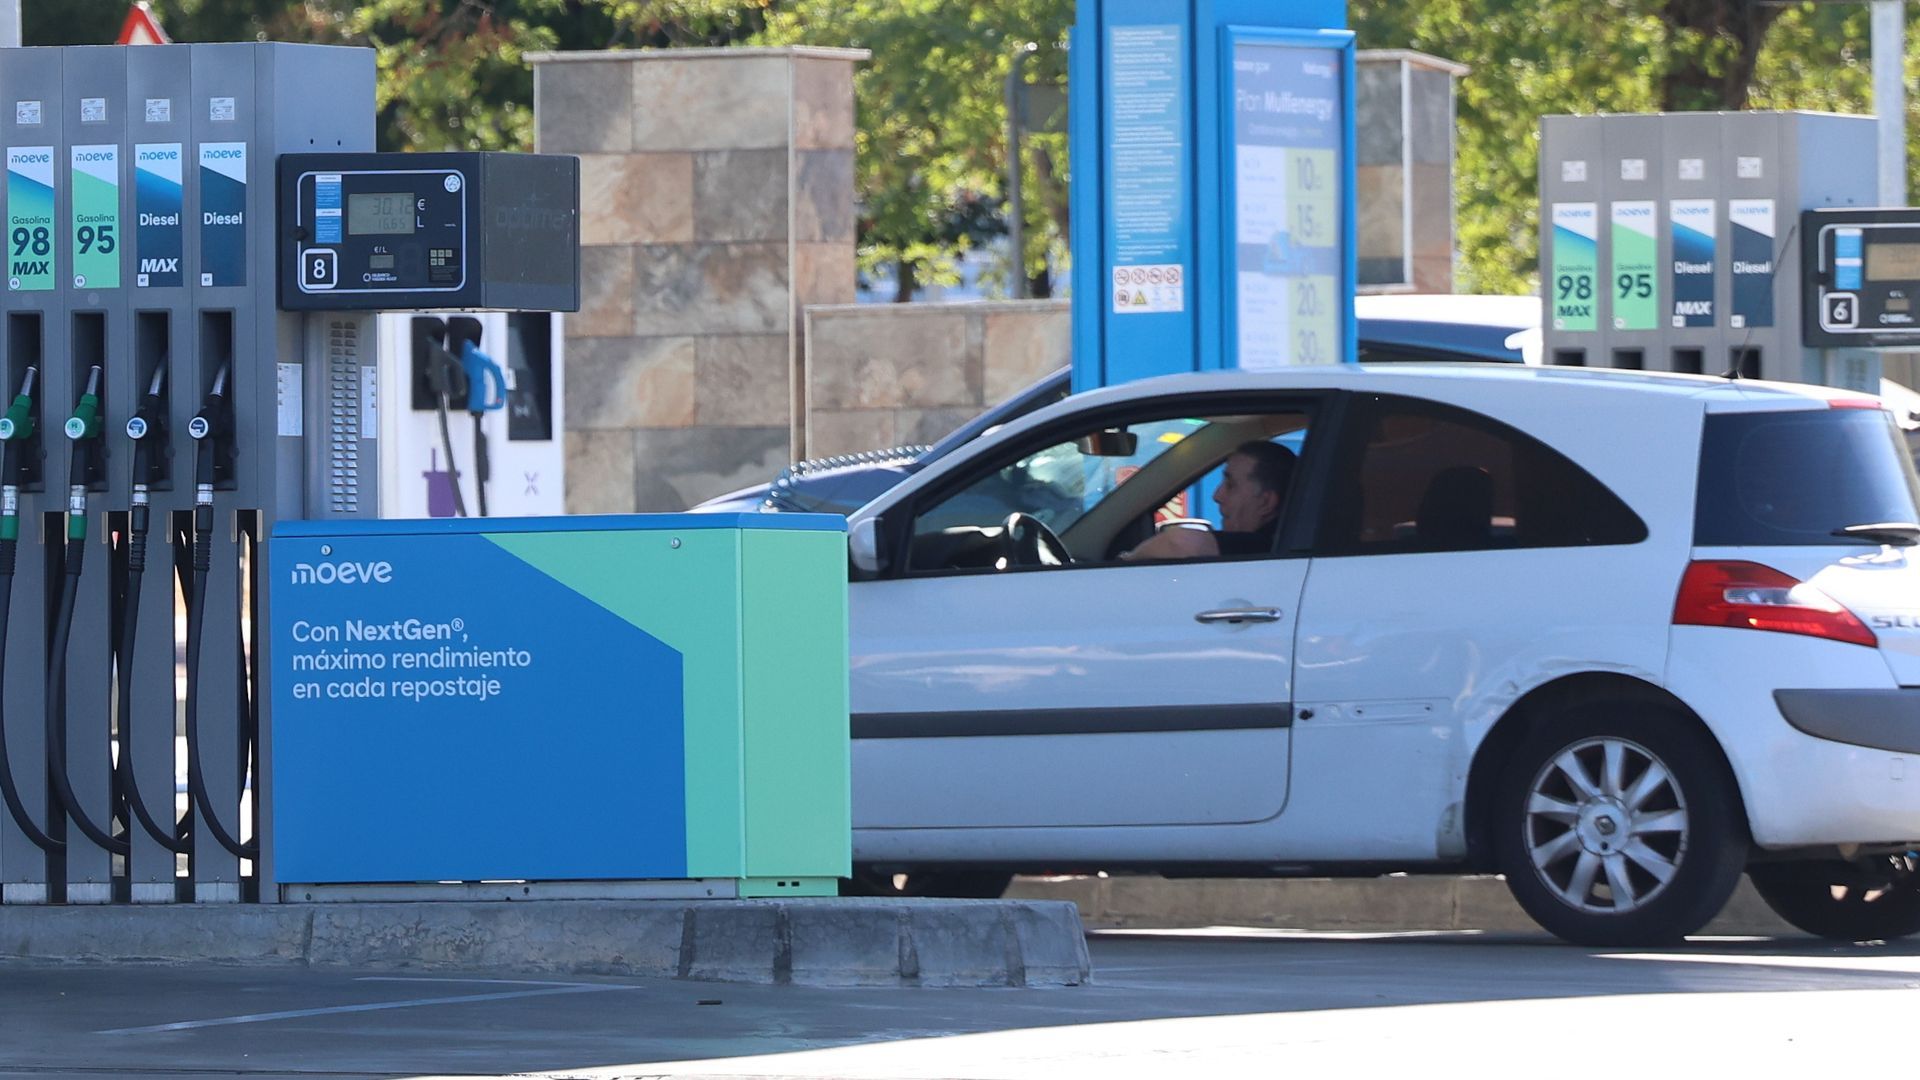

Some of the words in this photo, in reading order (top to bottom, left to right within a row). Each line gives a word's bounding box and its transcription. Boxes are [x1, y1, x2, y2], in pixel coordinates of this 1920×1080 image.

[11, 153, 50, 164] moeve
[75, 152, 113, 162] moeve
[139, 150, 178, 161] moeve
[203, 149, 242, 159] moeve
[12, 215, 50, 225] Gasolina
[76, 213, 115, 223] Gasolina
[139, 213, 179, 226] Diesel
[203, 212, 243, 225] Diesel
[417, 215, 425, 228] L
[12, 226, 50, 256] 98
[77, 225, 115, 254] 95
[12, 261, 50, 275] MAX
[140, 258, 179, 272] MAX
[313, 258, 326, 279] 8
[1674, 261, 1711, 274] Diesel
[1733, 261, 1771, 274] Diesel
[1558, 275, 1592, 300] 98
[1617, 273, 1652, 299] 95
[1557, 305, 1591, 317] MAX
[1675, 301, 1712, 315] MAX
[1833, 301, 1848, 321] 6
[291, 561, 393, 584] moeve
[292, 621, 339, 642] Con
[292, 649, 386, 670] máximo
[392, 646, 531, 669] rendimiento
[293, 682, 320, 699] en
[327, 677, 385, 698] cada
[392, 674, 501, 702] repostaje
